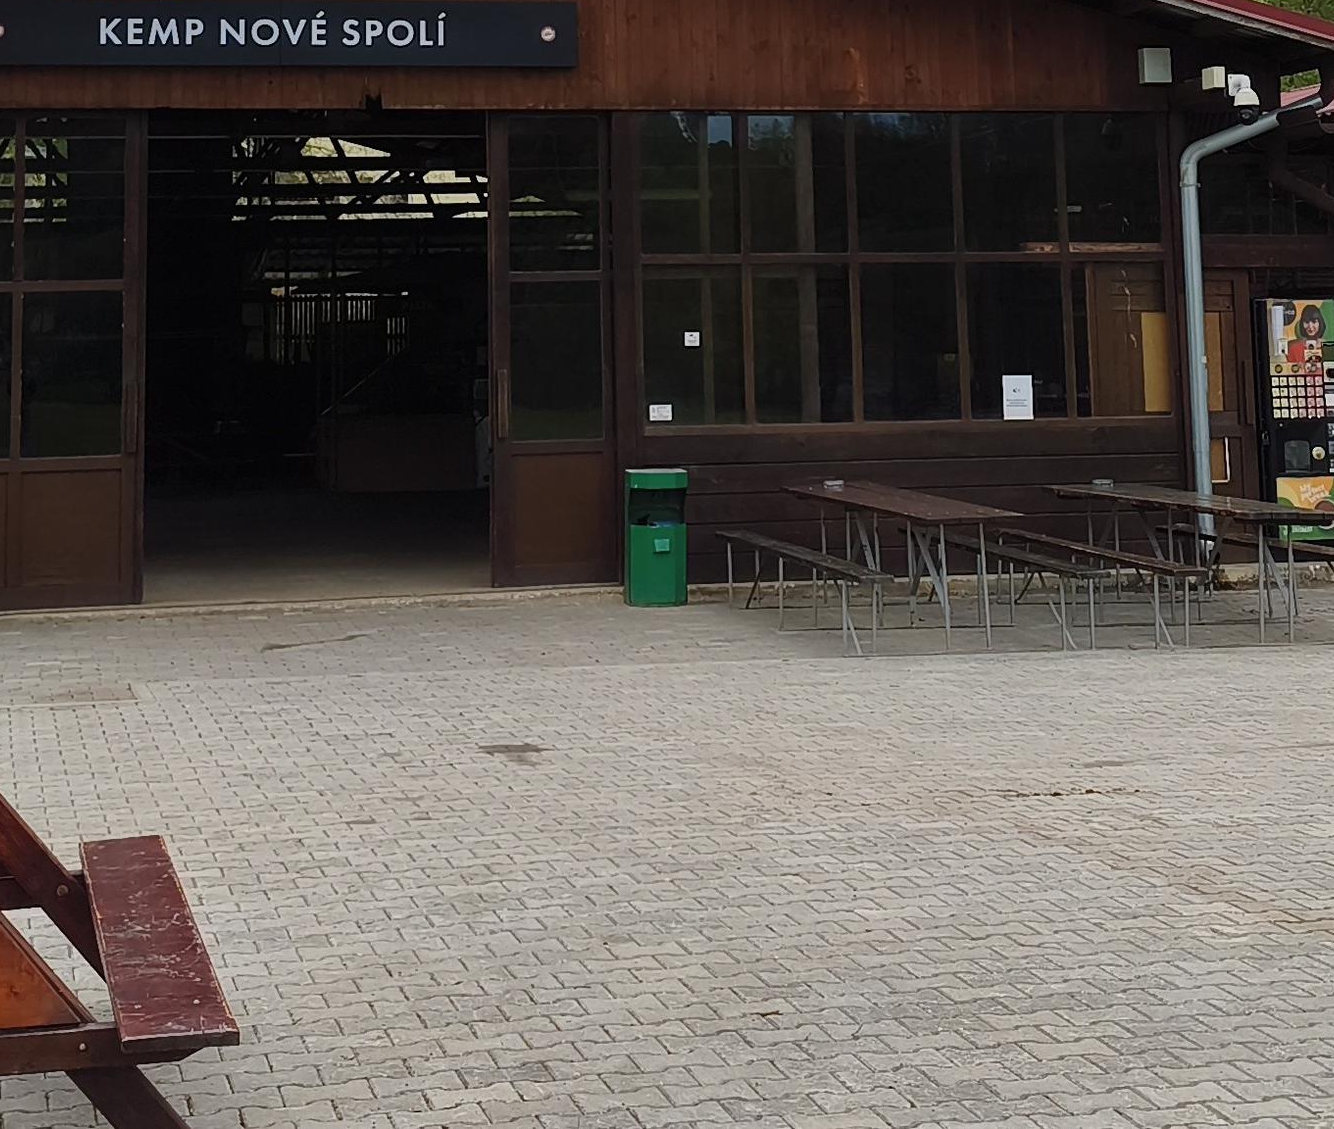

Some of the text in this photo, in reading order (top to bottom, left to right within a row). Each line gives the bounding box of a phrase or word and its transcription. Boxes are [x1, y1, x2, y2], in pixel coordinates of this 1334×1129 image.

[99, 11, 447, 47] KEMP NOVÉ SPOLÍ
